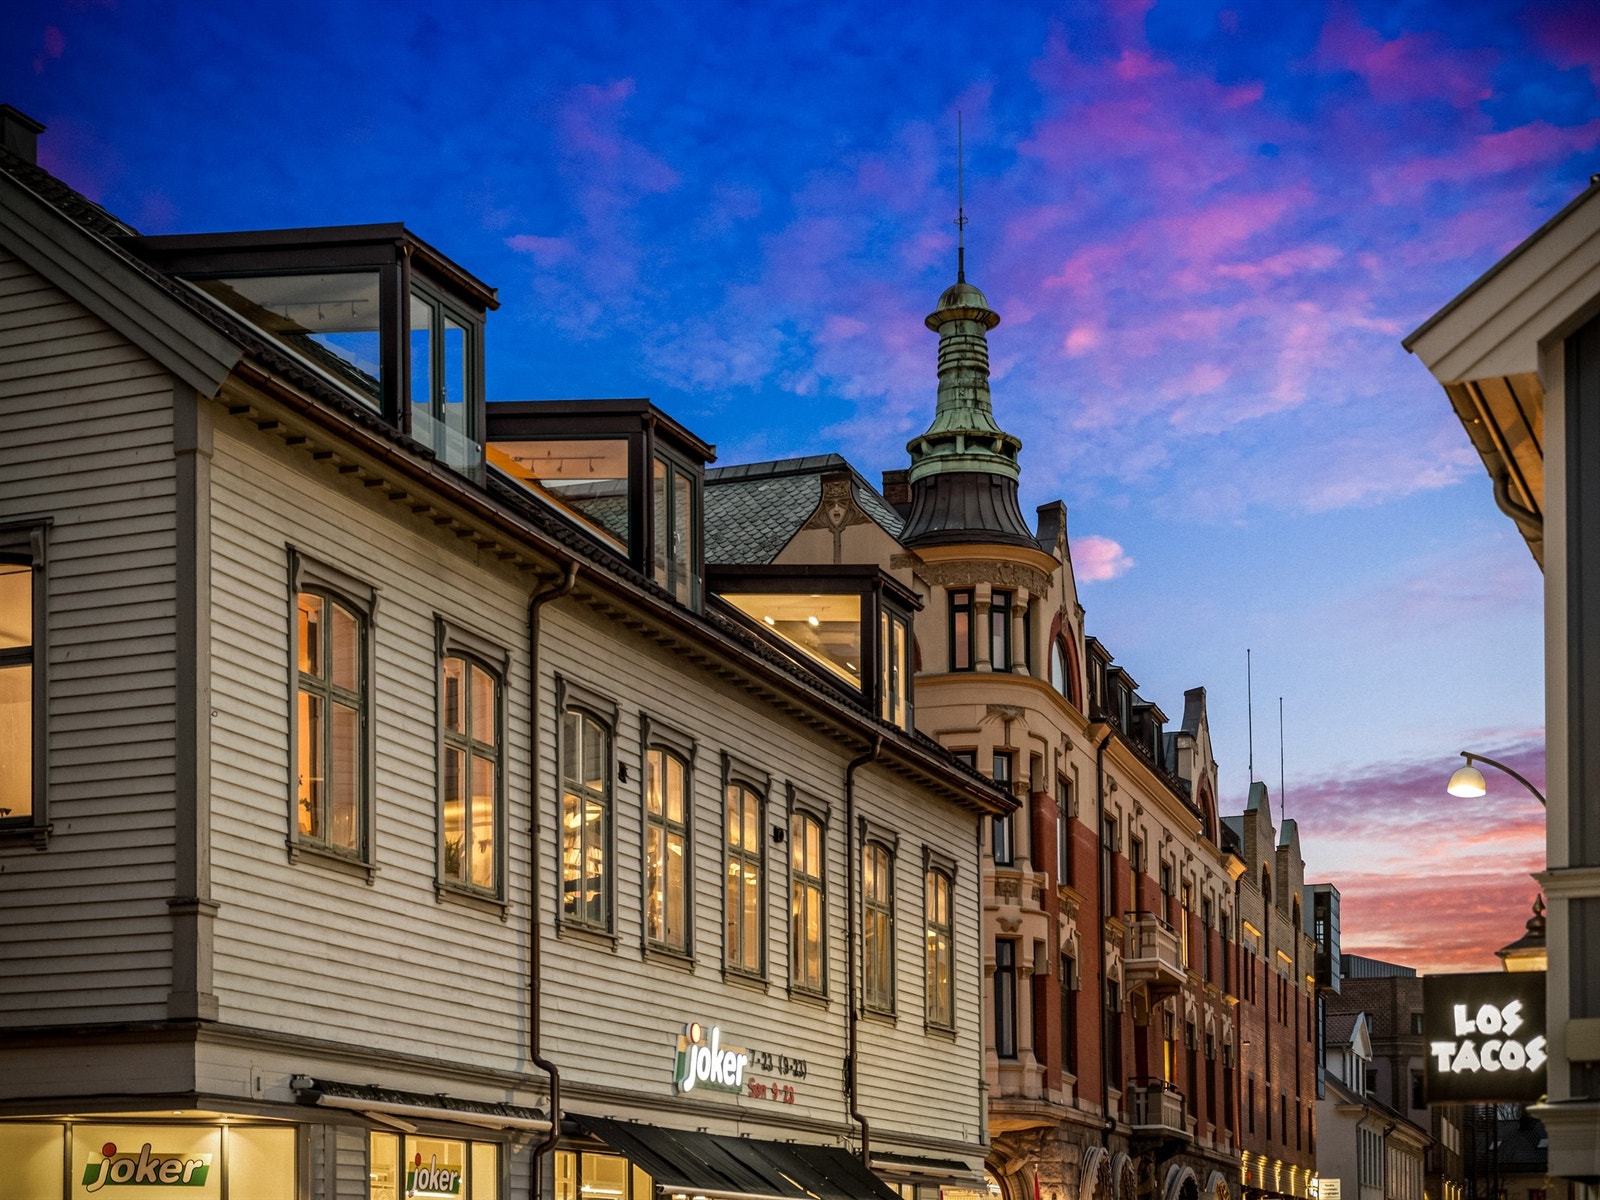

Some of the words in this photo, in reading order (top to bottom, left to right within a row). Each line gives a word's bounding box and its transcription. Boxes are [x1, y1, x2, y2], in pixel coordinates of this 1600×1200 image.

[1453, 1000, 1525, 1036] LOS
[683, 1022, 748, 1092] joker
[1430, 1035, 1548, 1073] TACOS
[86, 1142, 204, 1193] joker
[408, 1152, 459, 1198] joker
